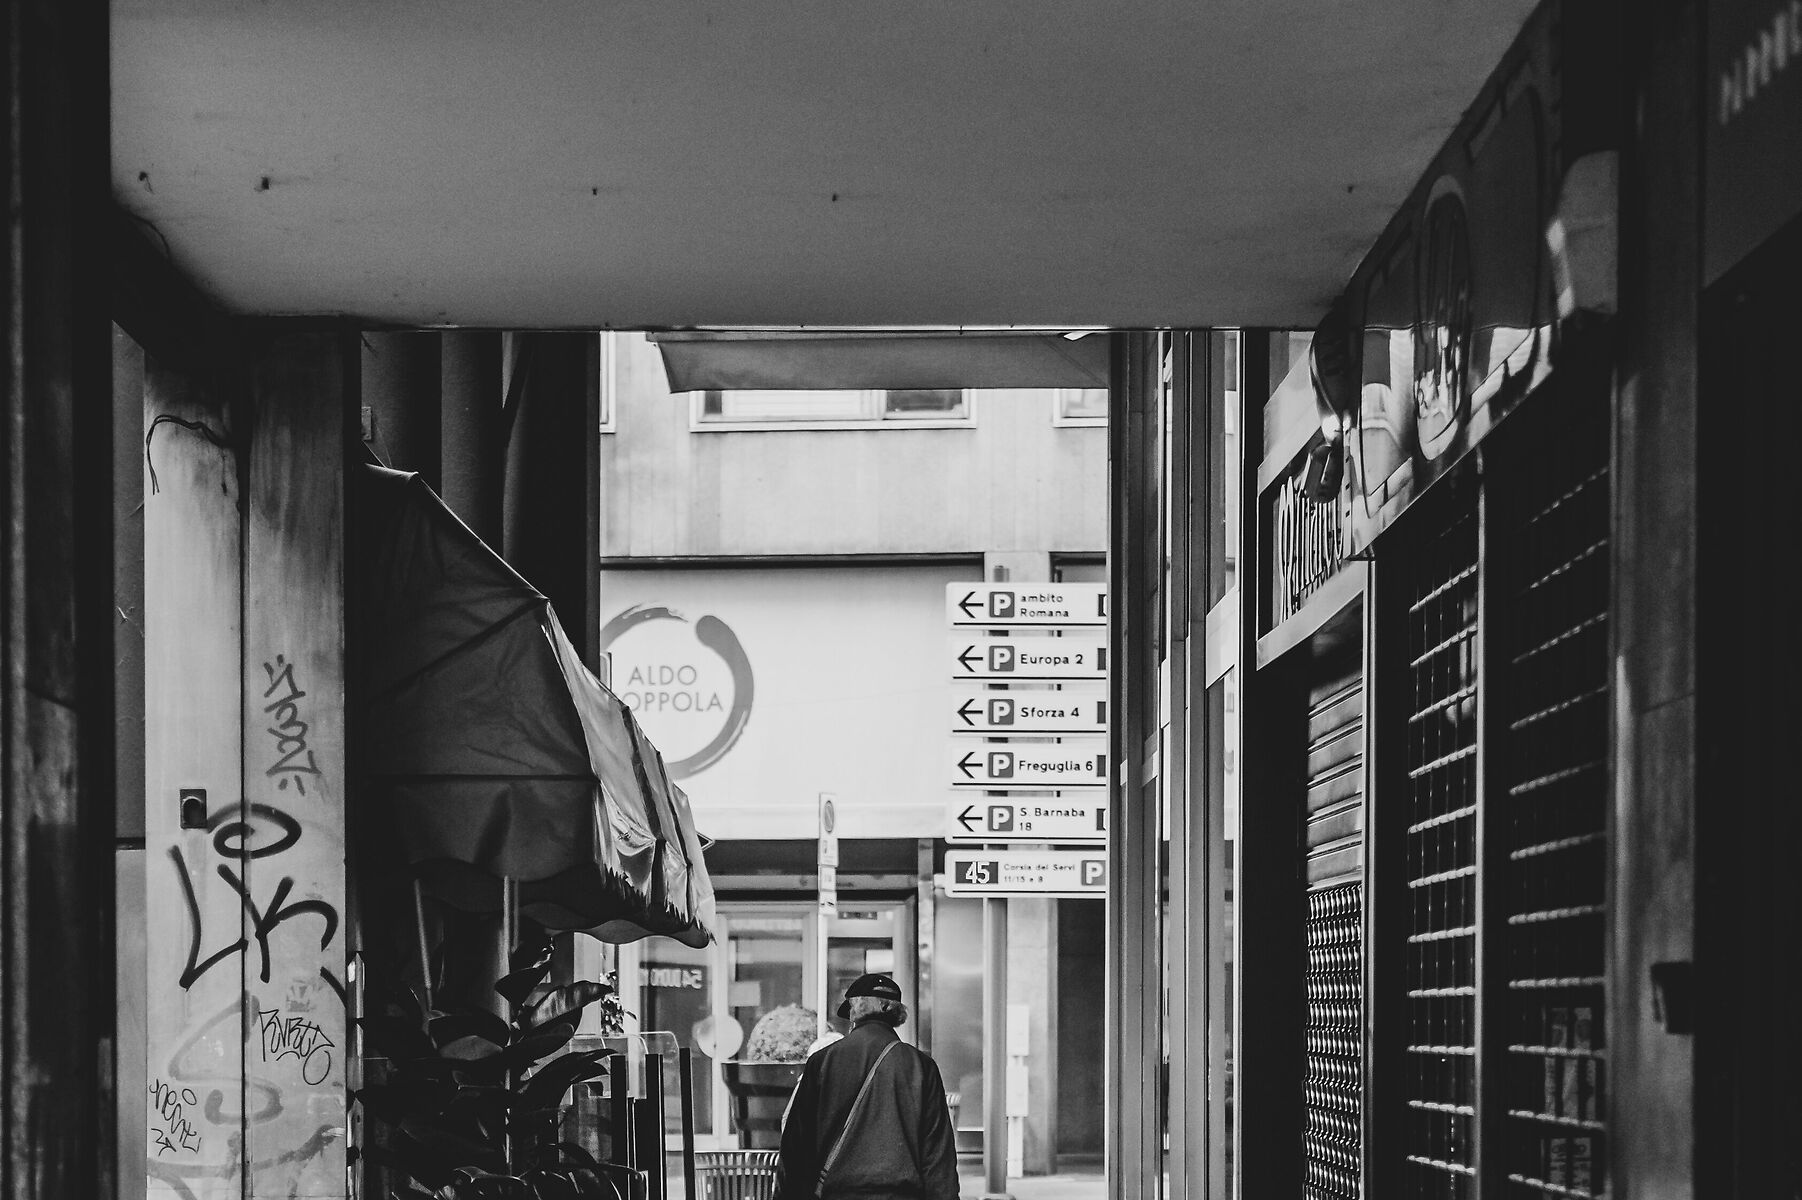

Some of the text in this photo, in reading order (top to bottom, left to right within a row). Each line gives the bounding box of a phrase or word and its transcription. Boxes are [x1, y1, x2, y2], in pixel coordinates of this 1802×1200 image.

[1020, 593, 1064, 603] ambito
[1020, 608, 1069, 618] Romana
[1020, 654, 1069, 667] Europa
[1075, 654, 1083, 665] 2
[628, 665, 697, 686] ALDO
[621, 691, 724, 712] OPPOLA
[1020, 707, 1065, 718] Sforza
[1071, 707, 1080, 717] 4
[1019, 760, 1081, 773] Freguglia
[1085, 760, 1093, 771] 6
[1035, 807, 1085, 817] Barnaba
[1020, 822, 1032, 831] 18
[965, 861, 990, 884] 45
